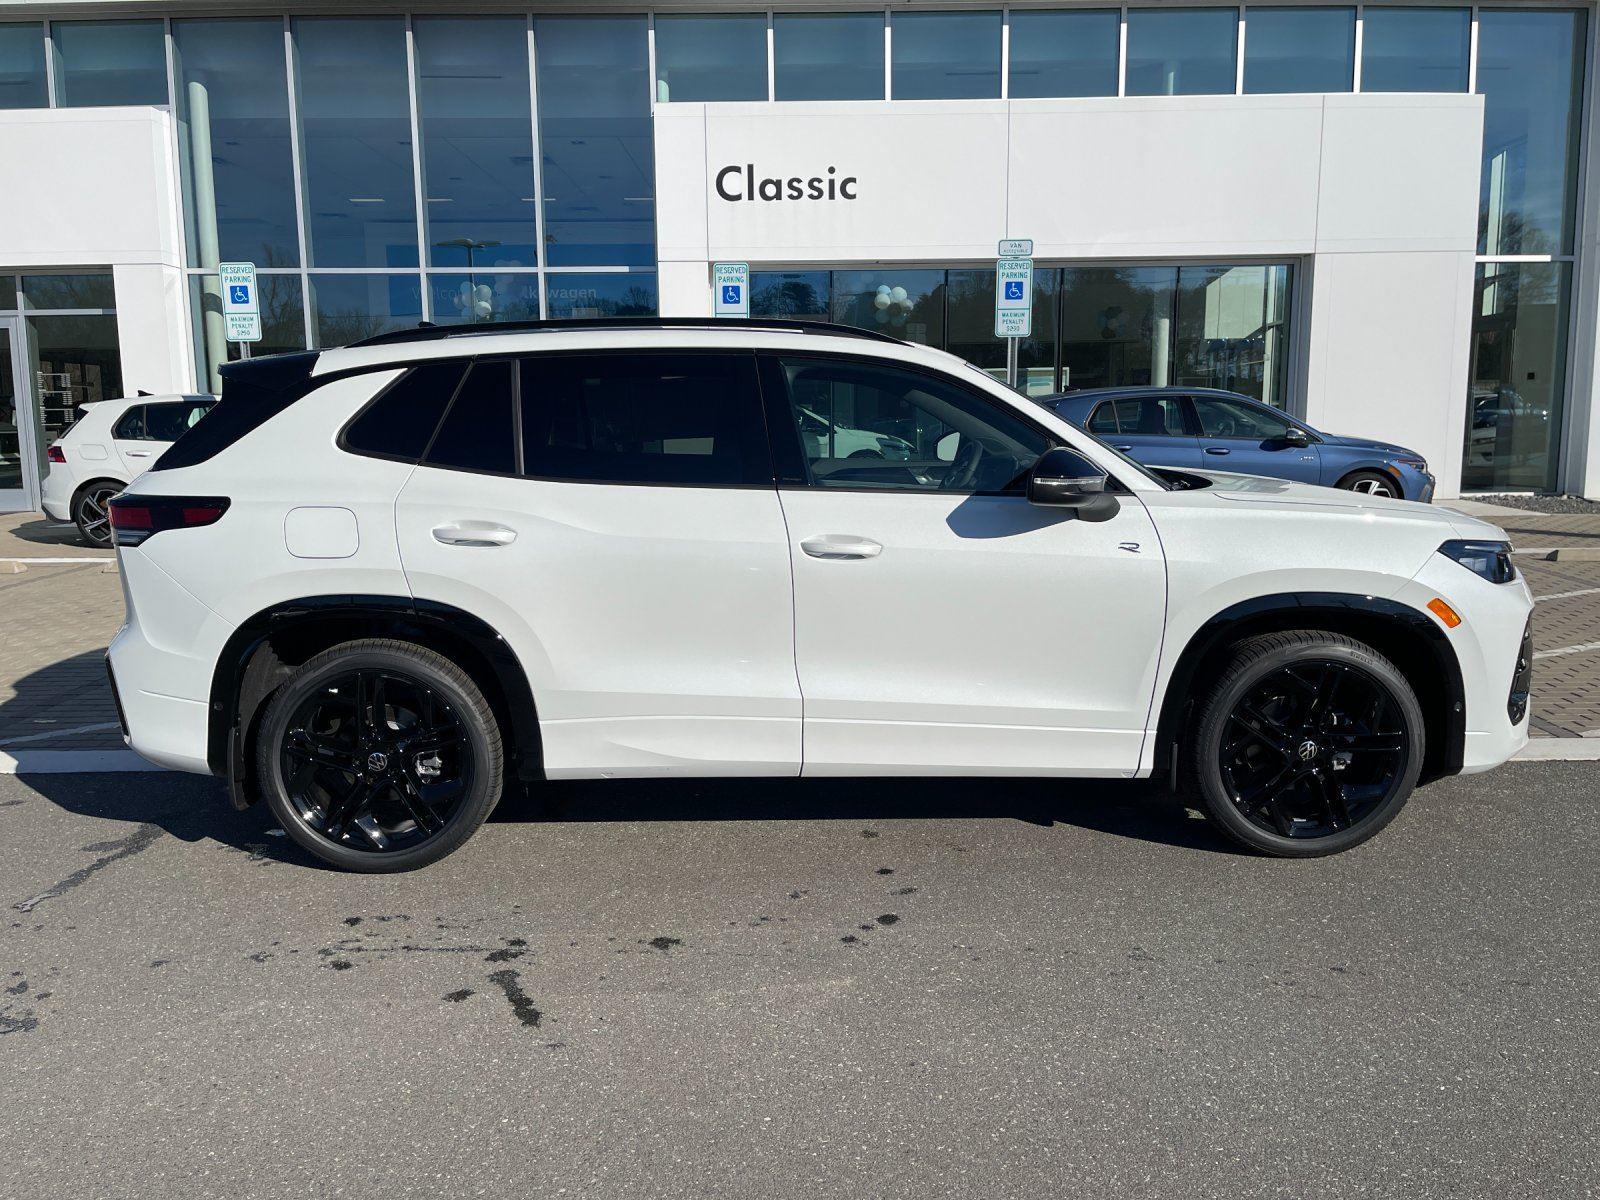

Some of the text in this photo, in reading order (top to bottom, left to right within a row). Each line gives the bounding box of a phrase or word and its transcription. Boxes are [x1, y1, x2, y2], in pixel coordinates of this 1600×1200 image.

[715, 163, 857, 202] Classic
[221, 266, 253, 274] RESERVED
[717, 266, 746, 274] RESERVED
[1000, 262, 1030, 270] RESERVED
[224, 275, 252, 283] PARKING
[718, 275, 745, 283] PARKING
[1001, 271, 1028, 279] PARKING
